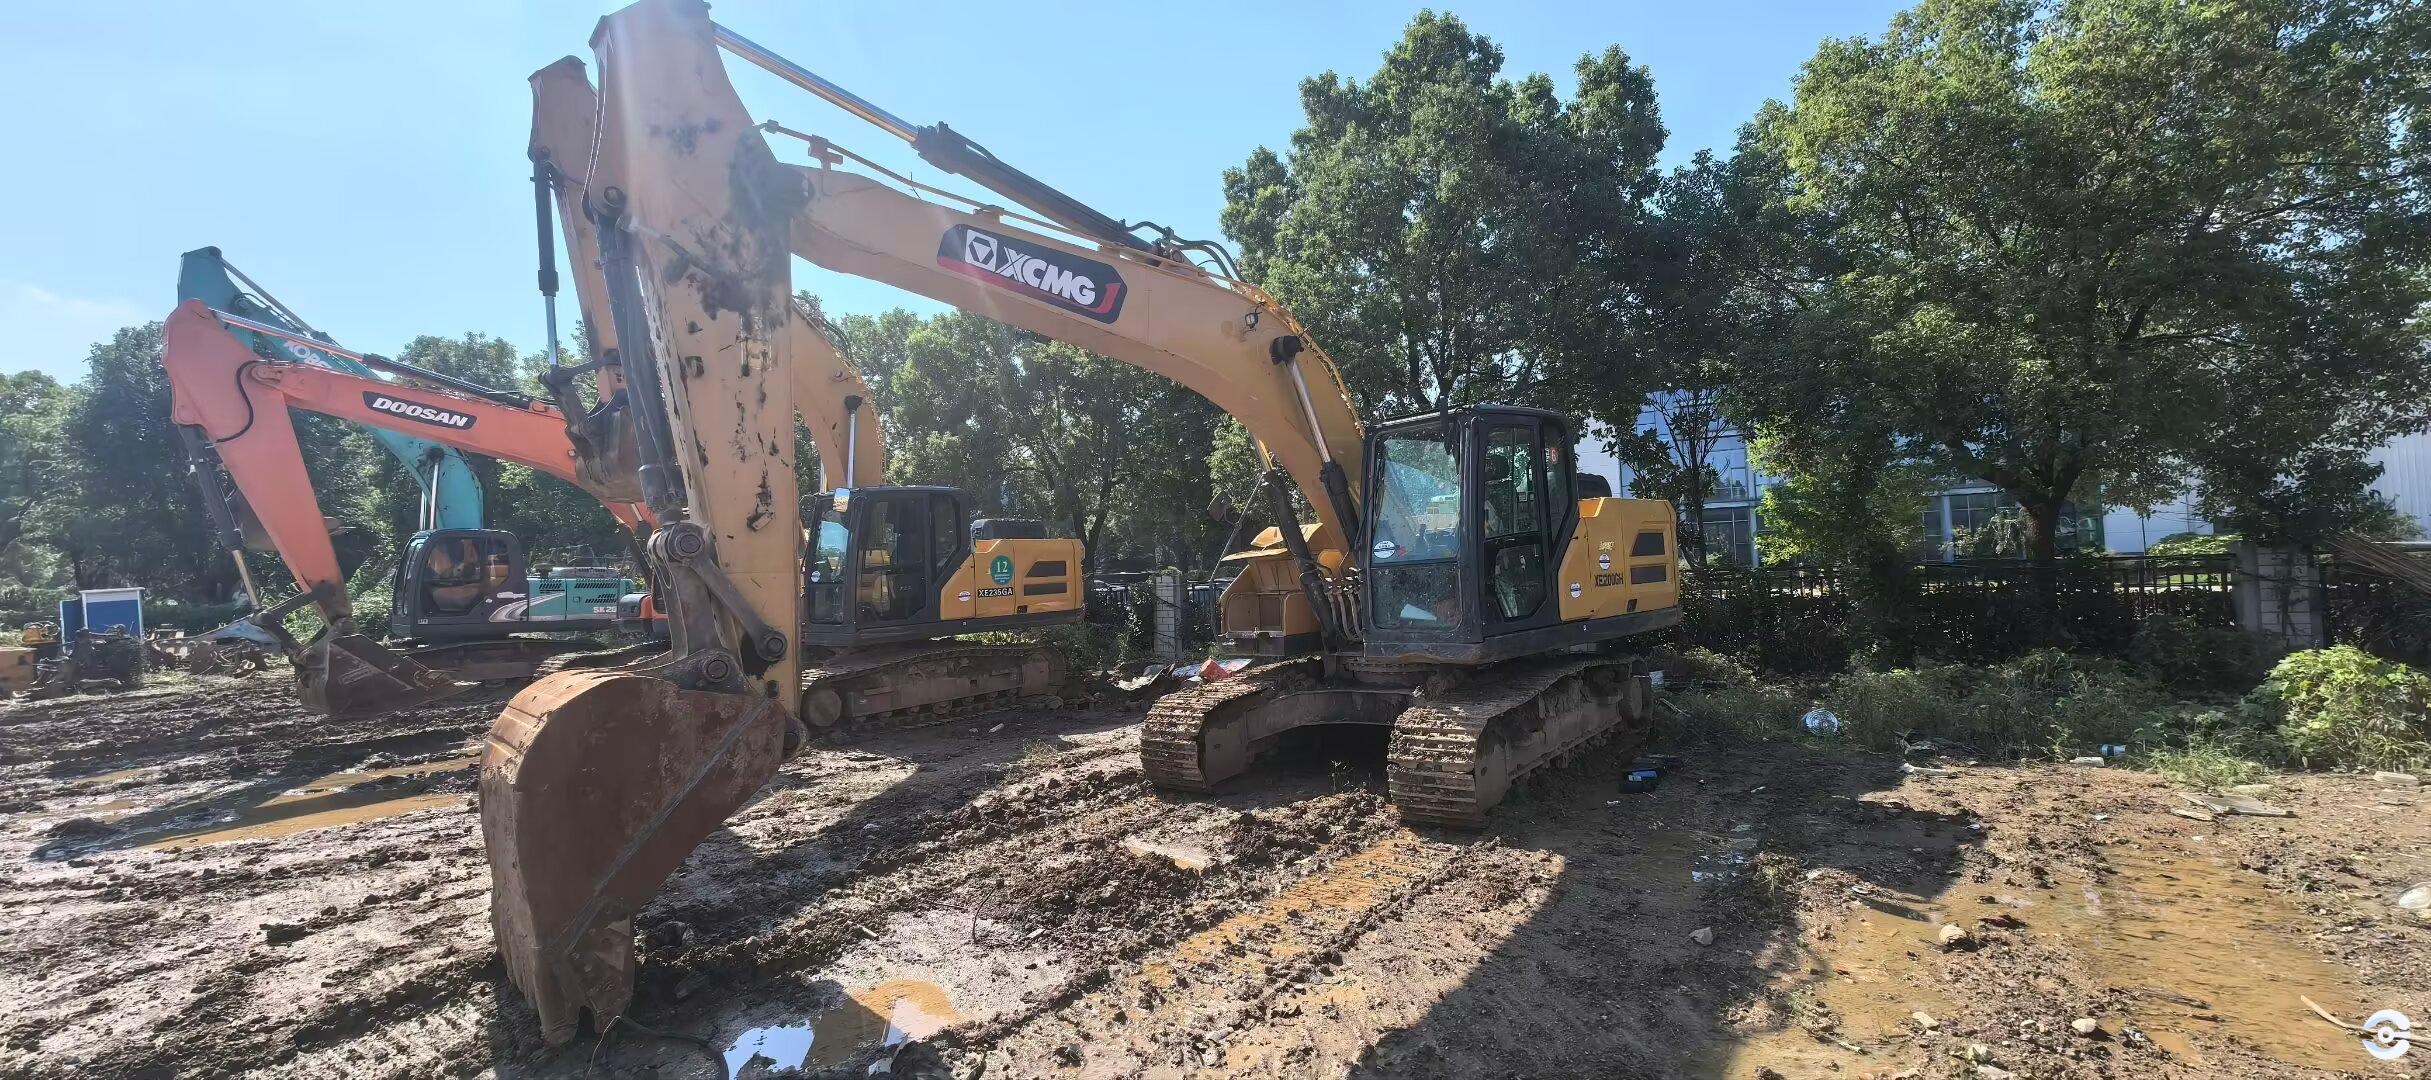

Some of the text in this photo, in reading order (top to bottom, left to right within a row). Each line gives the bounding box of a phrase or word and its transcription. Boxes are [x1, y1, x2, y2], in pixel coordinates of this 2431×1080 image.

[996, 247, 1095, 305] XCMG
[372, 397, 468, 427] DOOSAN
[996, 561, 1008, 573] 12
[978, 588, 1013, 597] XE235GA
